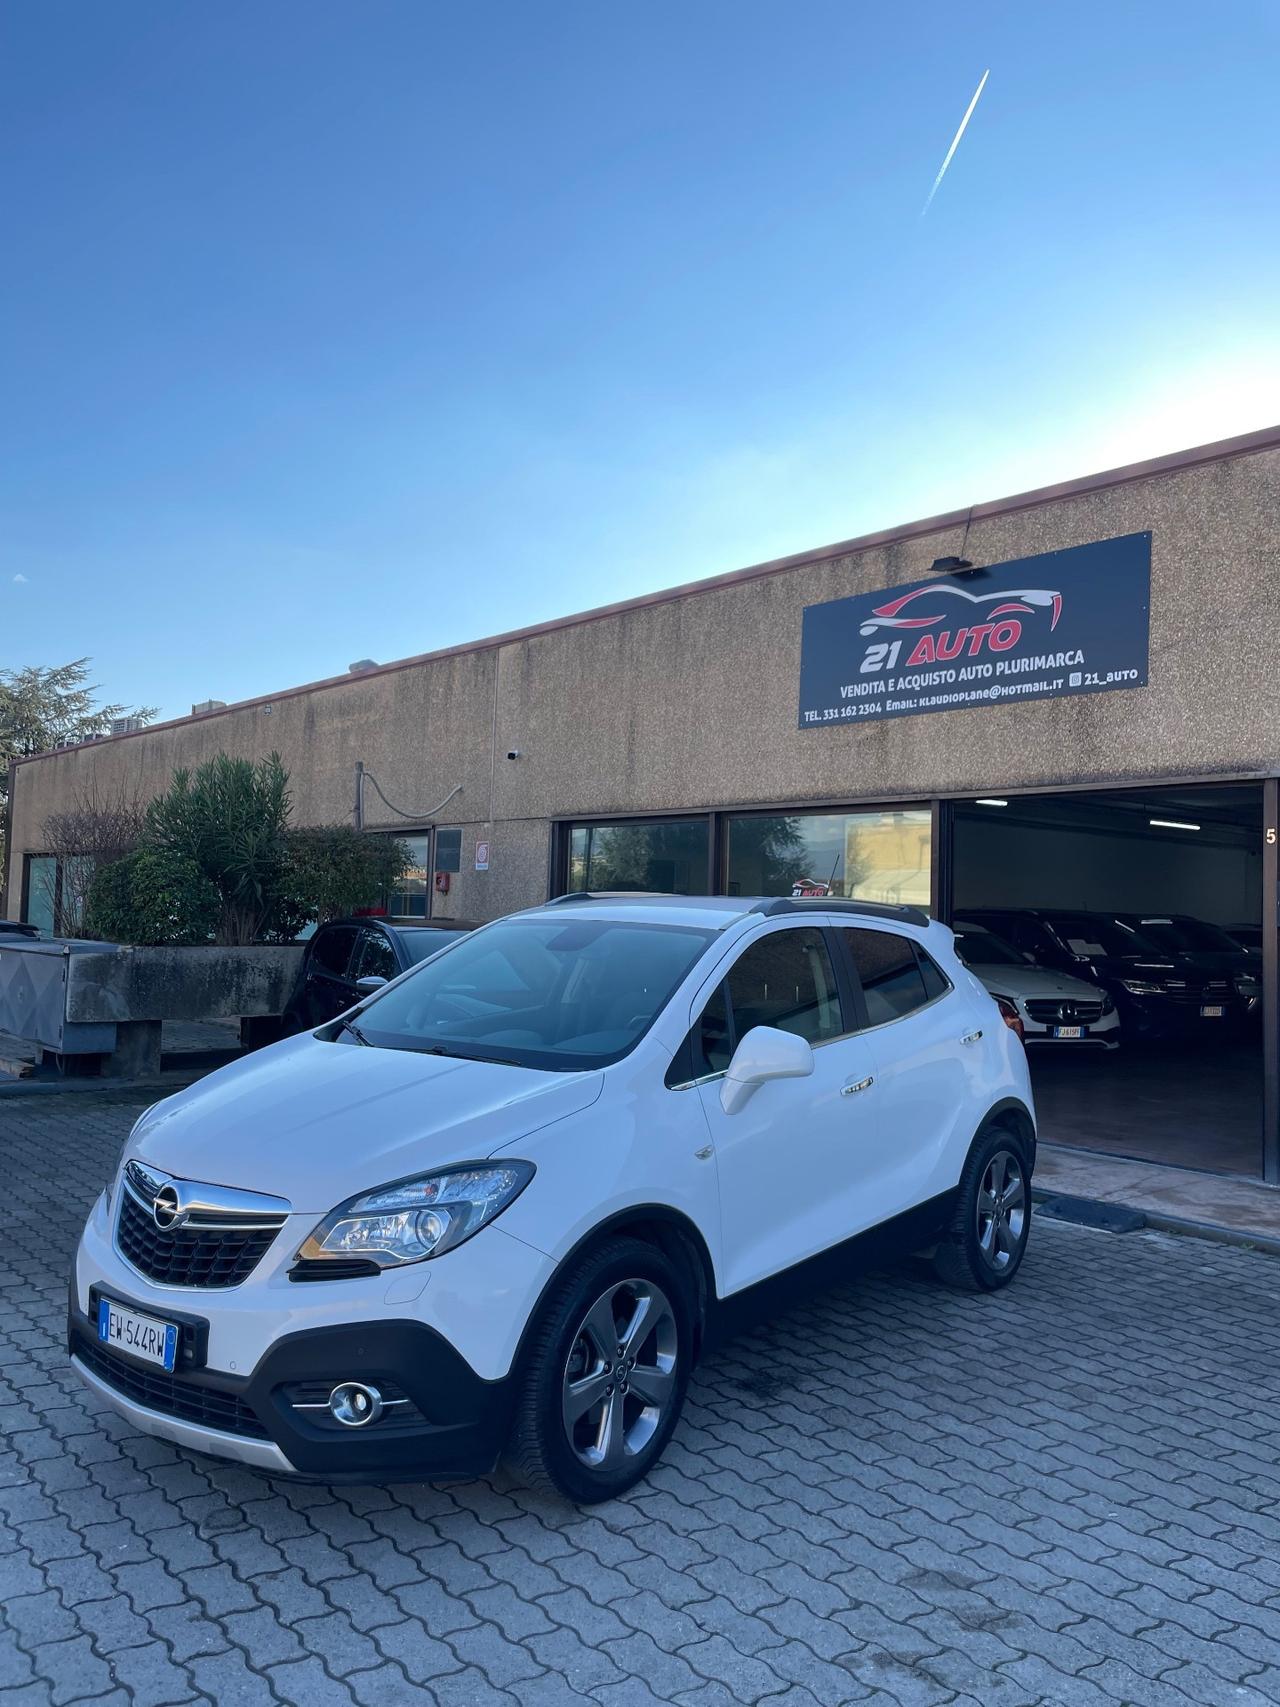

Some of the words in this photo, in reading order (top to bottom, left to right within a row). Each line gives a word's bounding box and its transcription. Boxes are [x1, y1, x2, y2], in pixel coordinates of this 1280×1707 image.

[859, 640, 902, 674] 21
[905, 619, 1022, 667] AUTO
[840, 680, 886, 699] VENDITA
[888, 679, 895, 692] E
[897, 670, 956, 691] ACQUISTO
[958, 665, 993, 681] AUTO
[996, 650, 1085, 676] PLURIMARCA
[804, 710, 822, 722] TEL.
[823, 707, 839, 720] 331
[840, 705, 857, 718] 162
[858, 702, 882, 715] 2304
[1266, 828, 1276, 844] 5
[802, 887, 824, 897] AUTO
[109, 1312, 123, 1340] EW
[126, 1320, 165, 1357] 544RW
